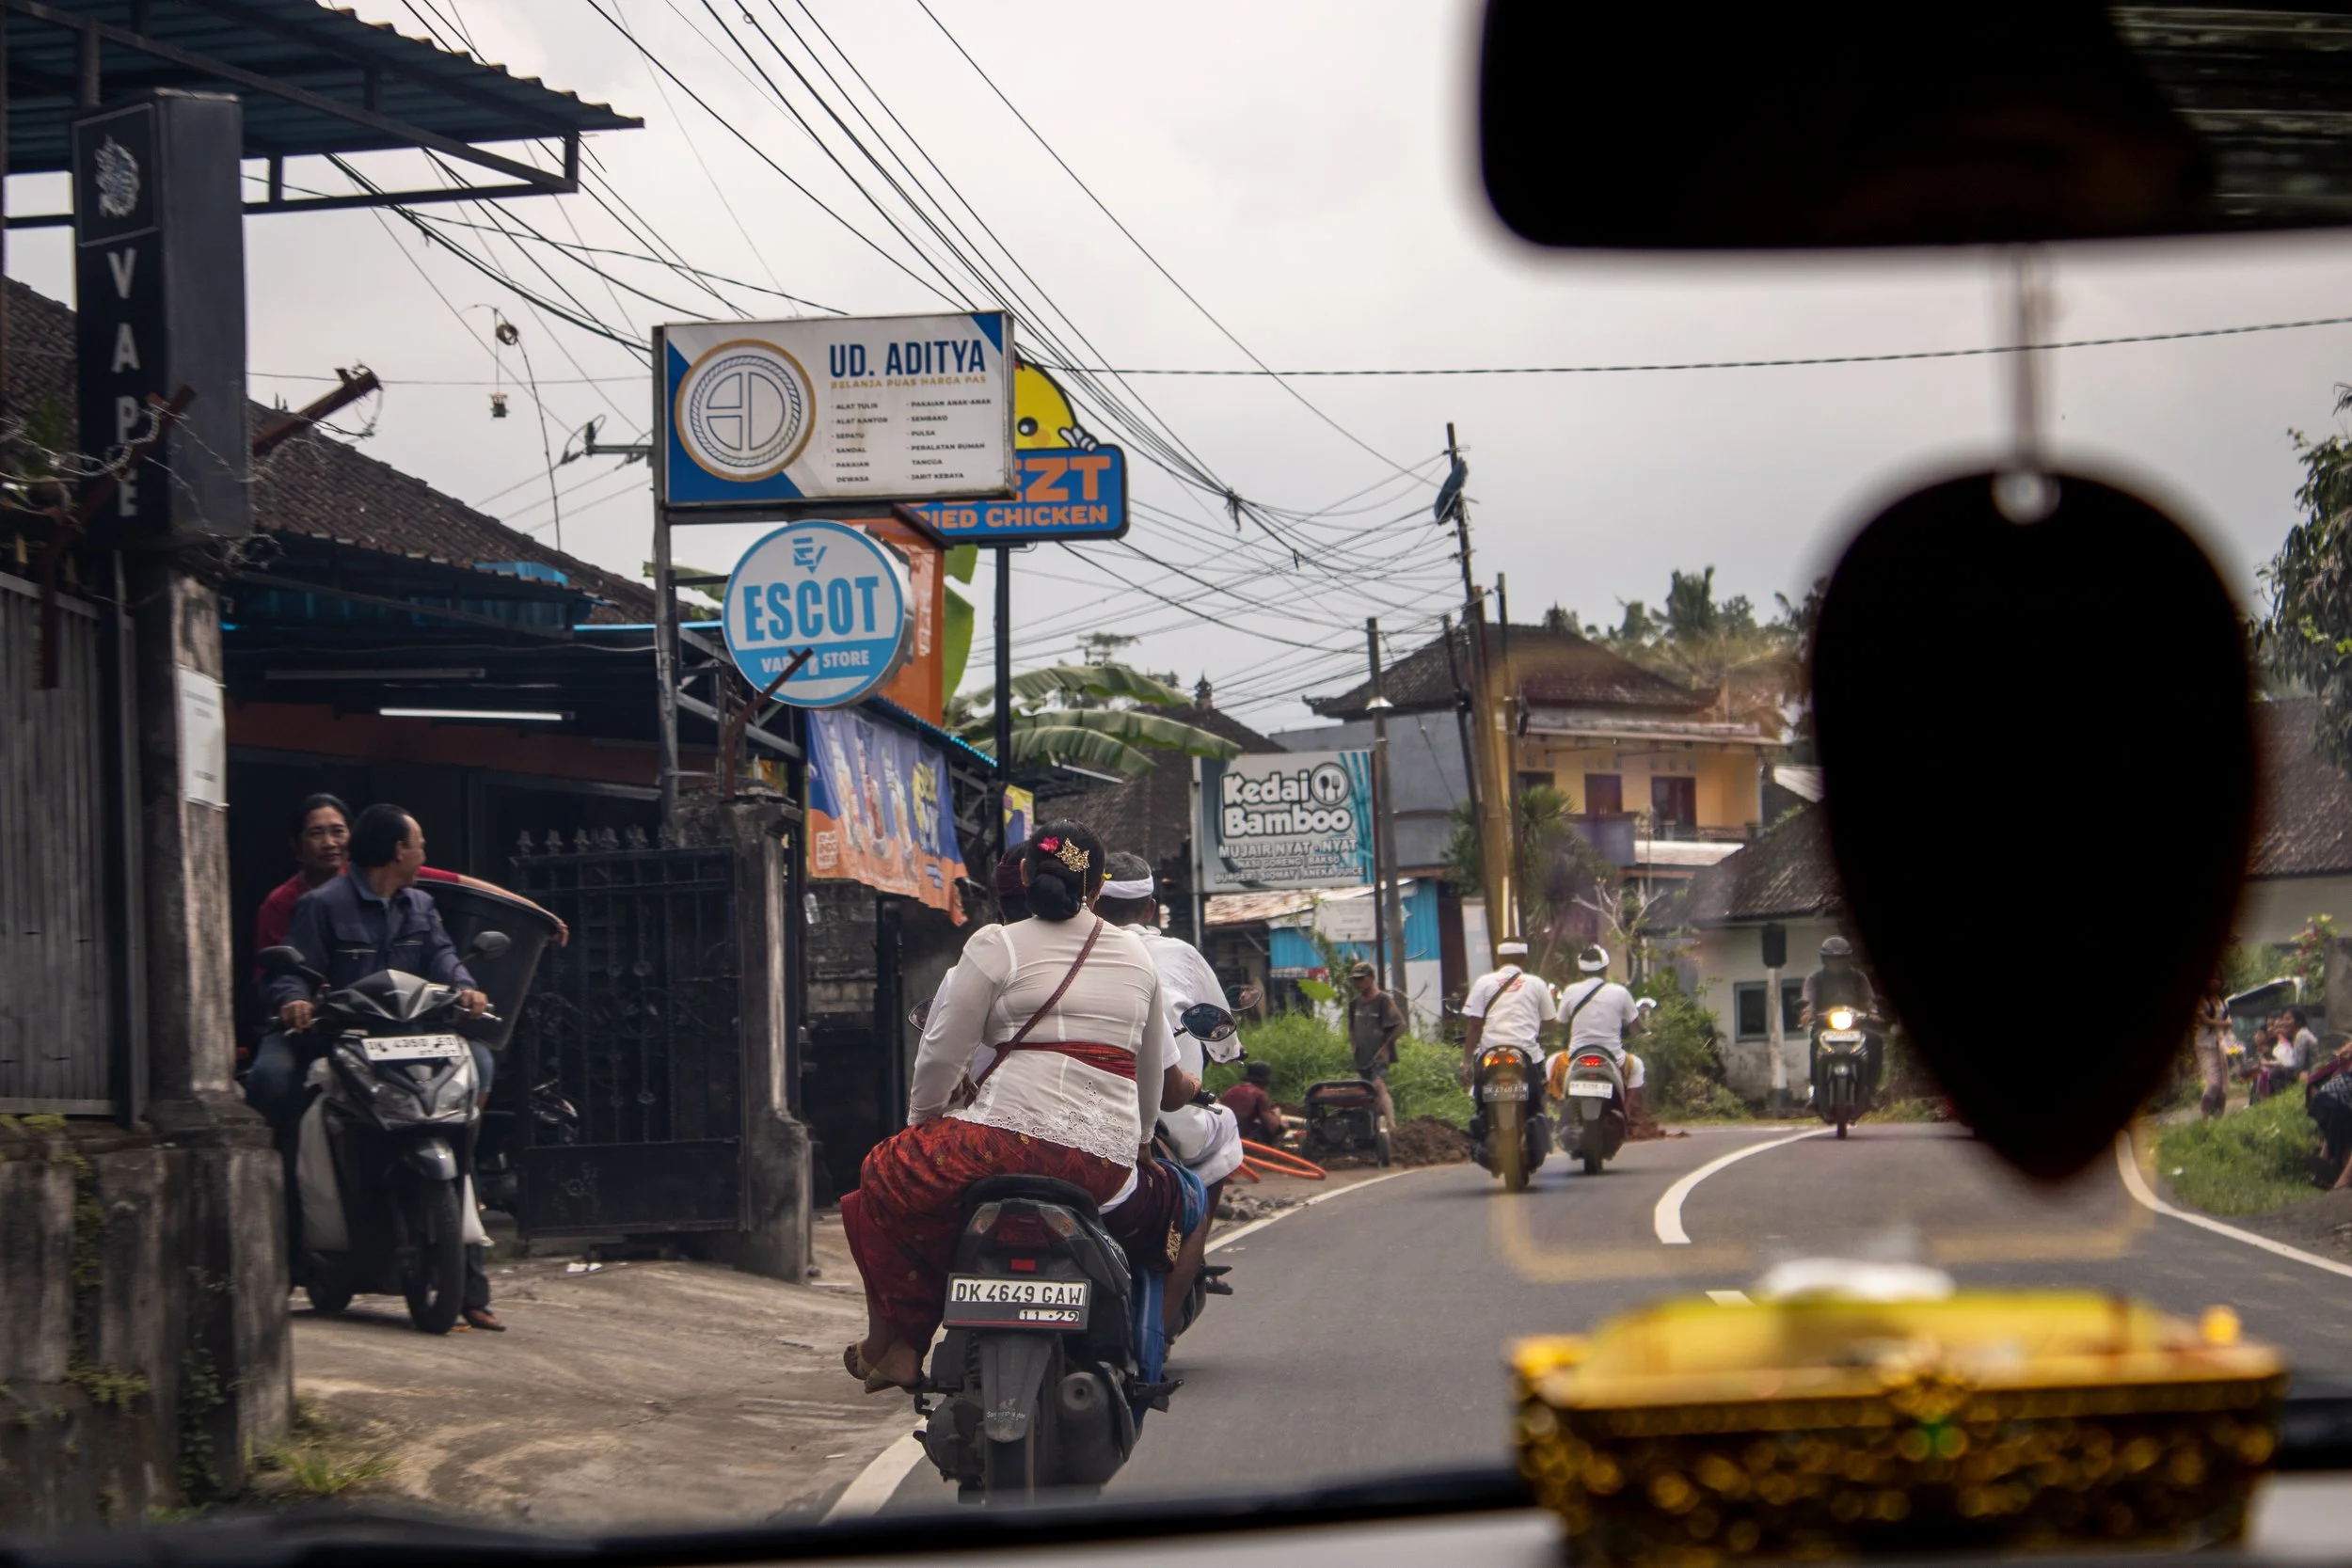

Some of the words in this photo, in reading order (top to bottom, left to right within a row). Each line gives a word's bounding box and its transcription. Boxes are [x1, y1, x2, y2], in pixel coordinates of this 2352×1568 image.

[830, 343, 875, 378] UD.
[885, 339, 987, 376] ADITYA
[830, 379, 882, 389] BELANJA
[887, 377, 916, 388] PUAS
[965, 375, 987, 384] PAS
[986, 505, 1108, 527] CHICKEN
[743, 576, 880, 641] ESCOT
[761, 655, 802, 673] VAP
[822, 650, 869, 669] STORE
[1222, 769, 1311, 805] Kedai
[1222, 804, 1352, 838] Bamboo
[1218, 843, 1272, 859] MUJAIR
[1275, 842, 1311, 857] NYAT
[1323, 839, 1358, 853] NYAT
[956, 1283, 981, 1301] DK
[986, 1285, 1035, 1303] 4649
[1041, 1287, 1083, 1305] GAW
